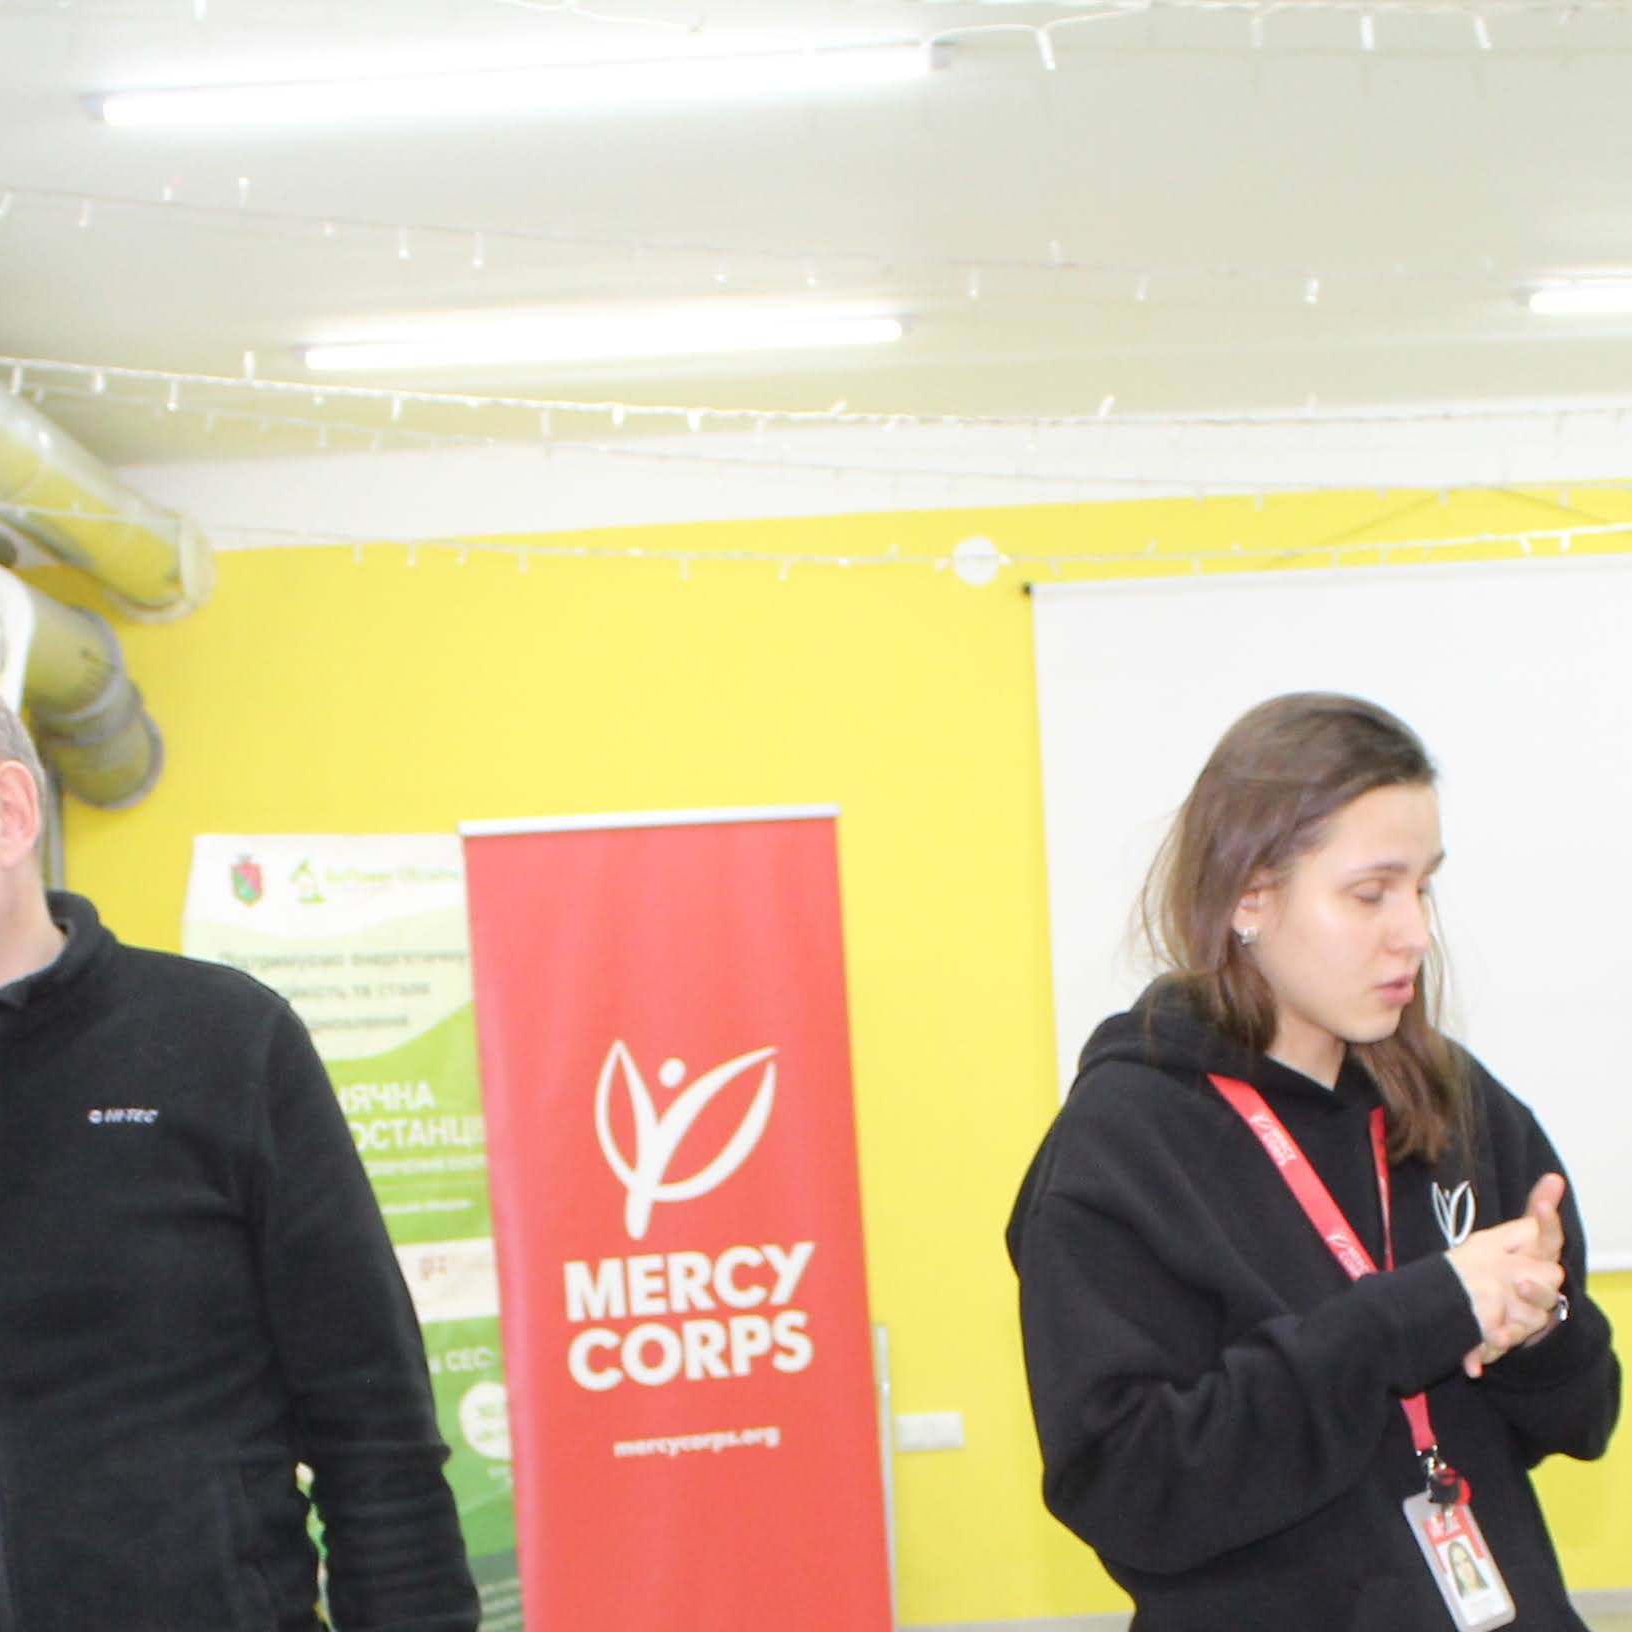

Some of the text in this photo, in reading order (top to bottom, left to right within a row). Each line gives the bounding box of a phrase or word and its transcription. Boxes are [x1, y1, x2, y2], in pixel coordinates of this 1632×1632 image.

[565, 1241, 816, 1322] MERCY
[567, 1310, 814, 1393] CORPS
[614, 1426, 780, 1459] mercycorps.org
